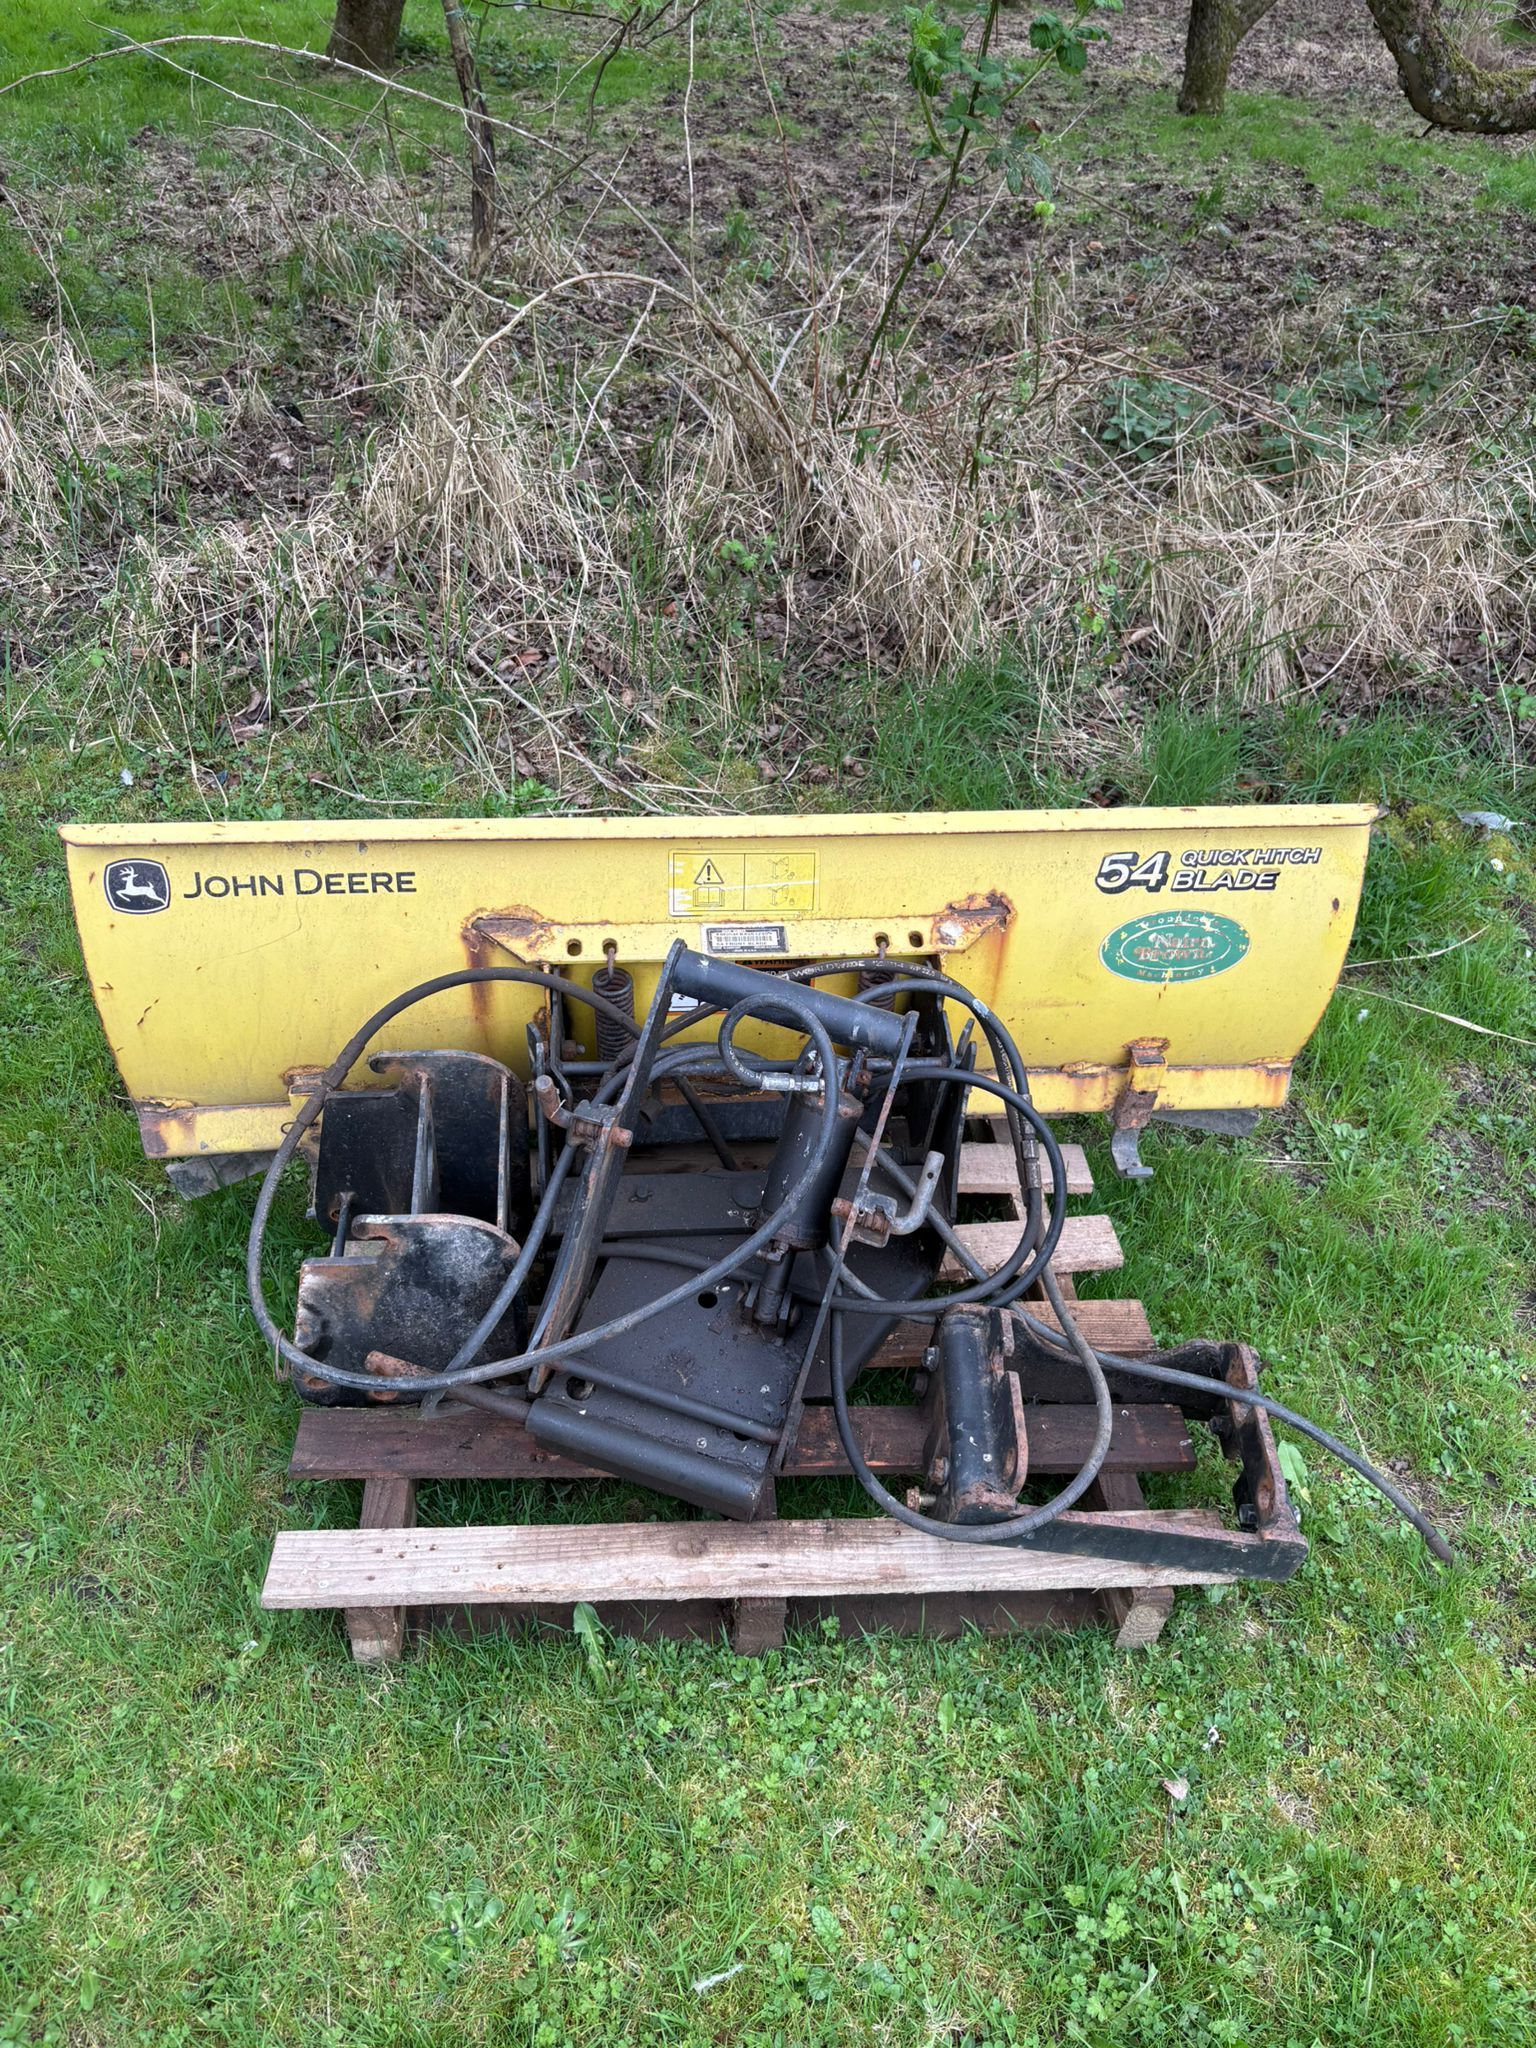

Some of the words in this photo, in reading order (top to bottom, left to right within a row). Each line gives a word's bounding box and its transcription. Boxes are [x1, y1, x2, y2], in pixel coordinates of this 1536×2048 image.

[1180, 848, 1250, 868] QUICK
[1252, 847, 1323, 865] HITCH
[183, 871, 285, 899] JOHN
[293, 868, 417, 896] DEERE
[1095, 850, 1172, 895] 54
[1171, 869, 1281, 893] BLADE
